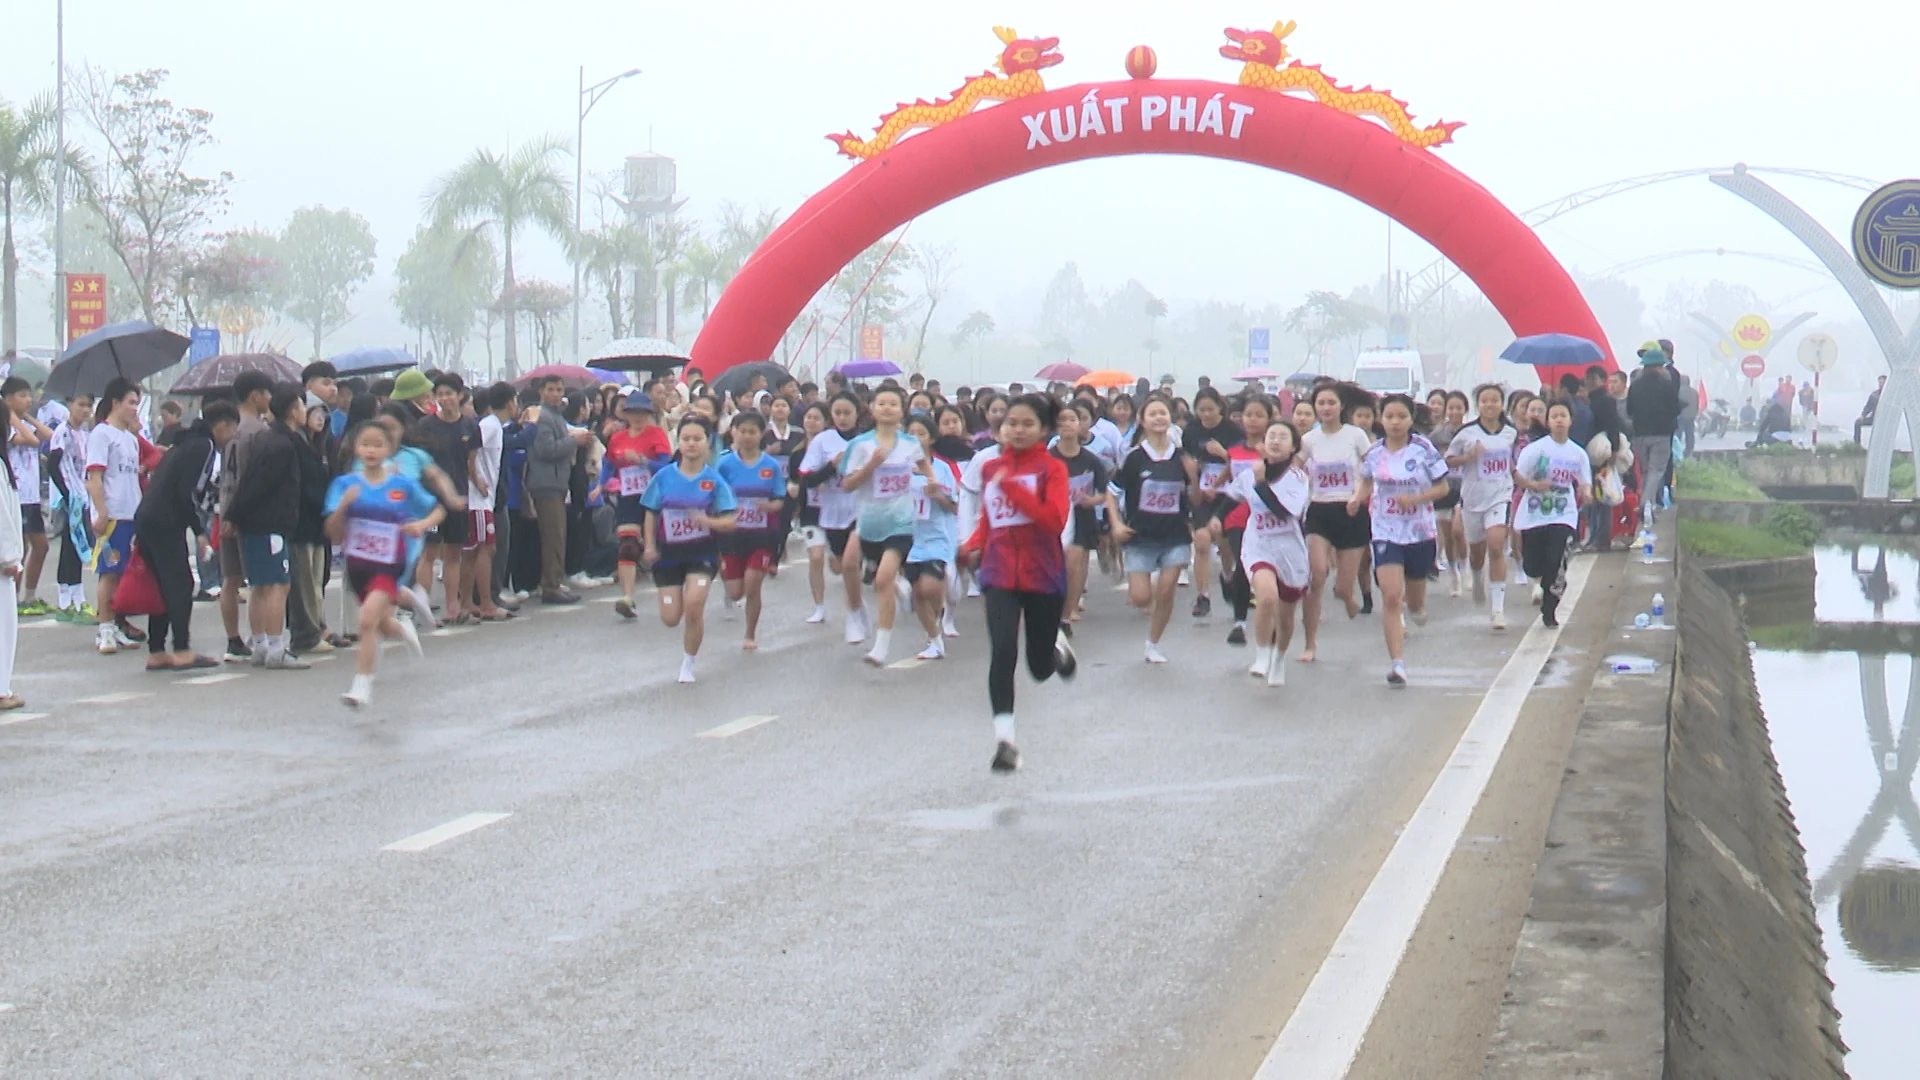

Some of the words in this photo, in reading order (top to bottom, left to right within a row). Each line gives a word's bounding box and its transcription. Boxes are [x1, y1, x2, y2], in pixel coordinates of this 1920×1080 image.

[1021, 89, 1129, 150] XUẤT
[1141, 93, 1254, 139] PHÁT
[1483, 458, 1508, 475] 300
[1317, 472, 1348, 488] 264
